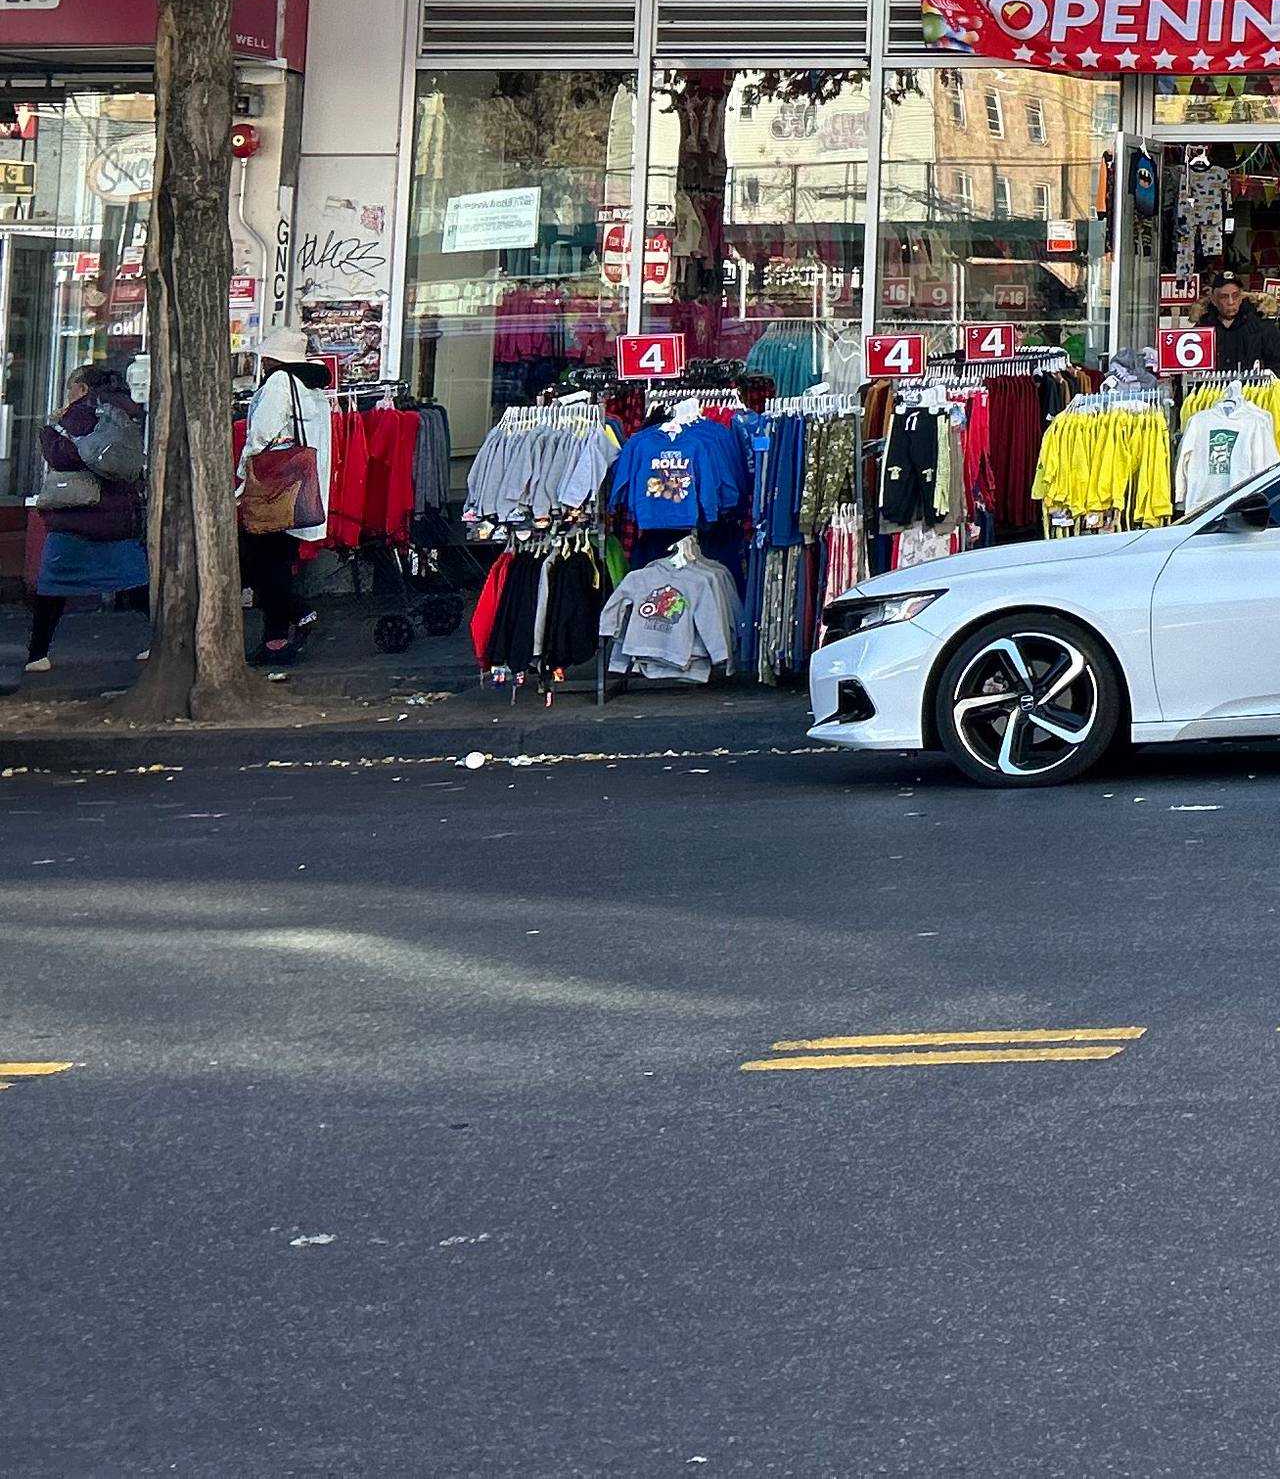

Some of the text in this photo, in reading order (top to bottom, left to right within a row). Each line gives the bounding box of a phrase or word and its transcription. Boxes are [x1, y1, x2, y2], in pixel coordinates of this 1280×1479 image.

[873, 339, 913, 374] $4
[971, 328, 1005, 358] $4
[1165, 332, 1204, 368] $6
